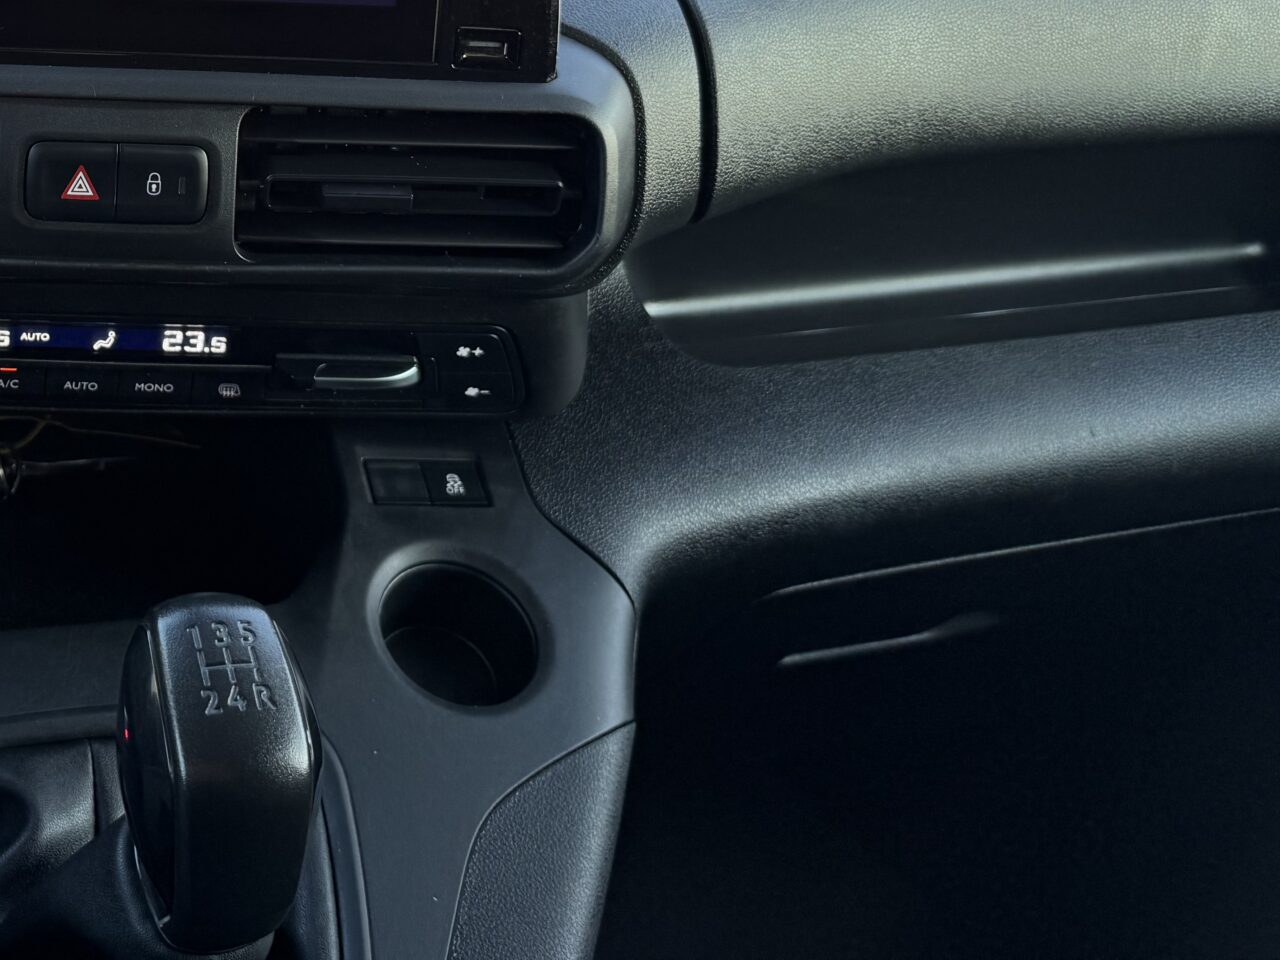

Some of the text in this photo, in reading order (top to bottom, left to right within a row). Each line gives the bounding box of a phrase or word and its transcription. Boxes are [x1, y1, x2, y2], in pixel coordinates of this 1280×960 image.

[20, 332, 50, 342] AUTO
[162, 330, 227, 354] 23.5
[64, 380, 99, 391] AUTO
[134, 382, 174, 393] MONO
[187, 619, 256, 650] 1 3 5
[201, 682, 276, 716] 2 4 R
